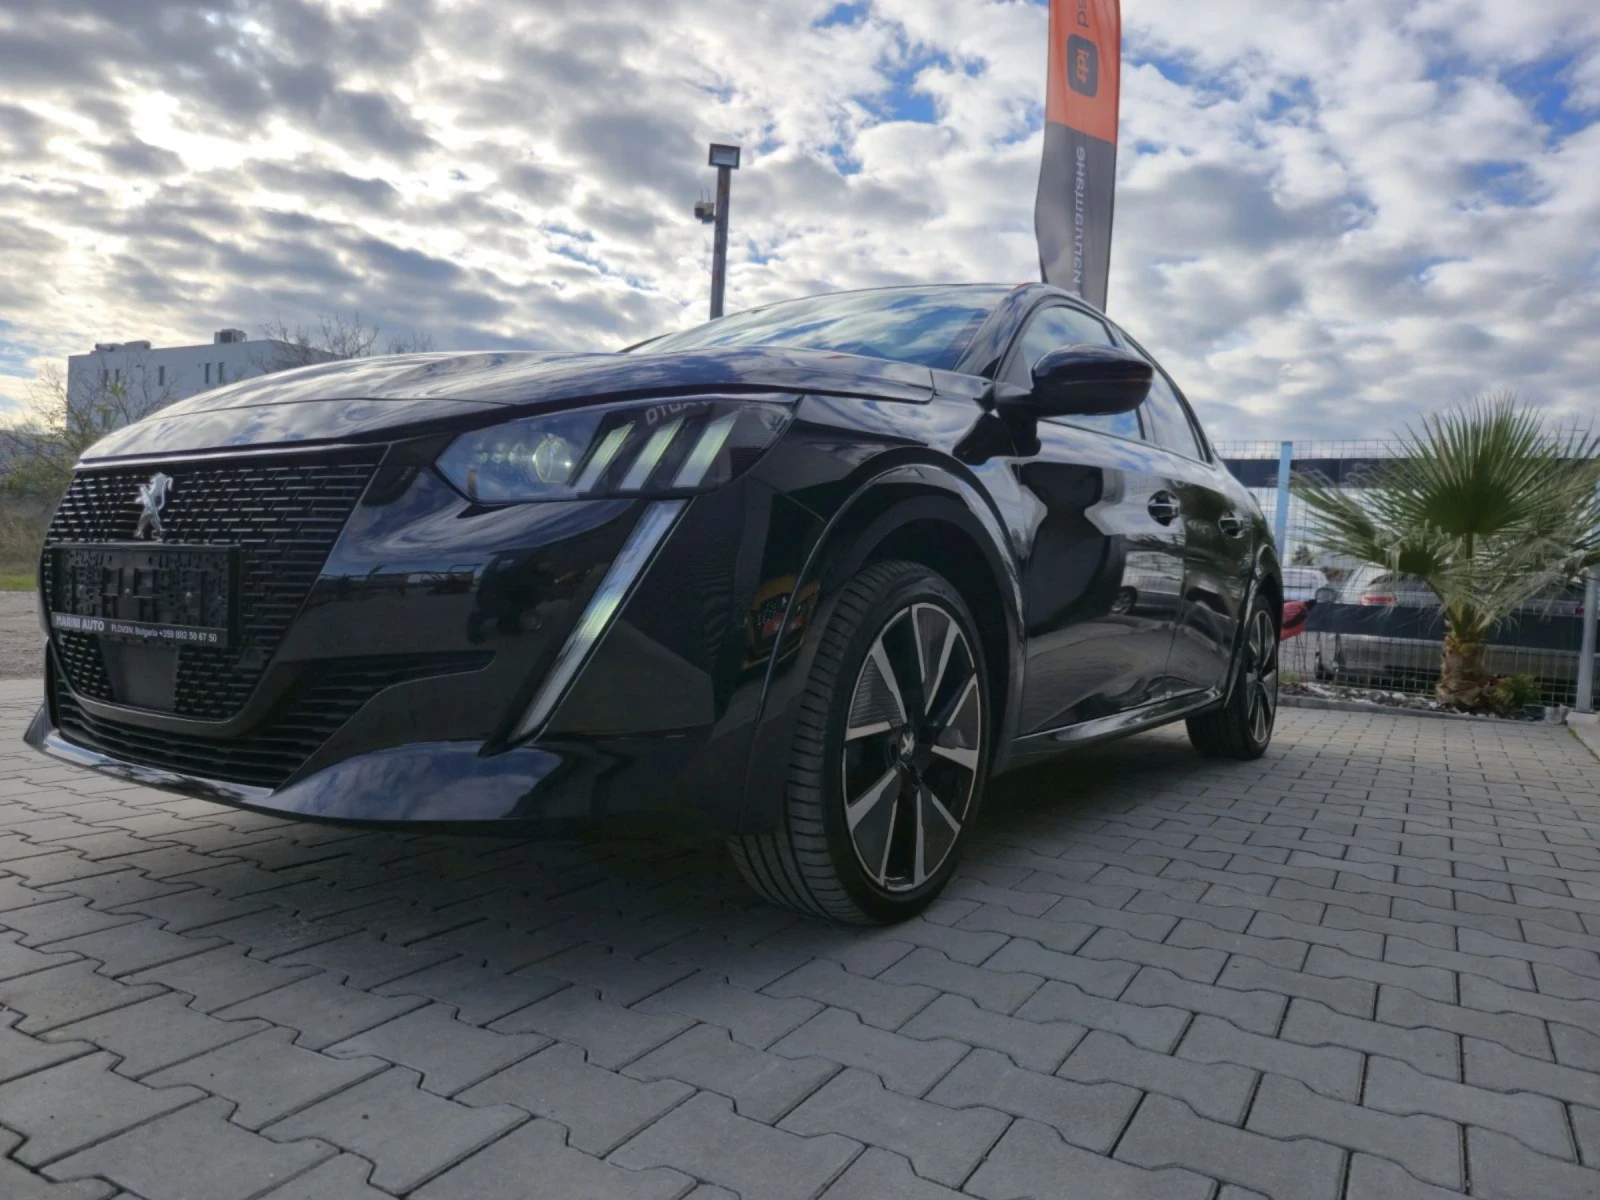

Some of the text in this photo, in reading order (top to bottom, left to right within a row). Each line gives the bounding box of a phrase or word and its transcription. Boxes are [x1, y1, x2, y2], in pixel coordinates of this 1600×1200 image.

[56, 615, 80, 629] MARINI
[82, 617, 105, 631] AUTO
[135, 626, 158, 638] Bulgaria
[159, 629, 174, 639] +359
[175, 630, 187, 640] 882
